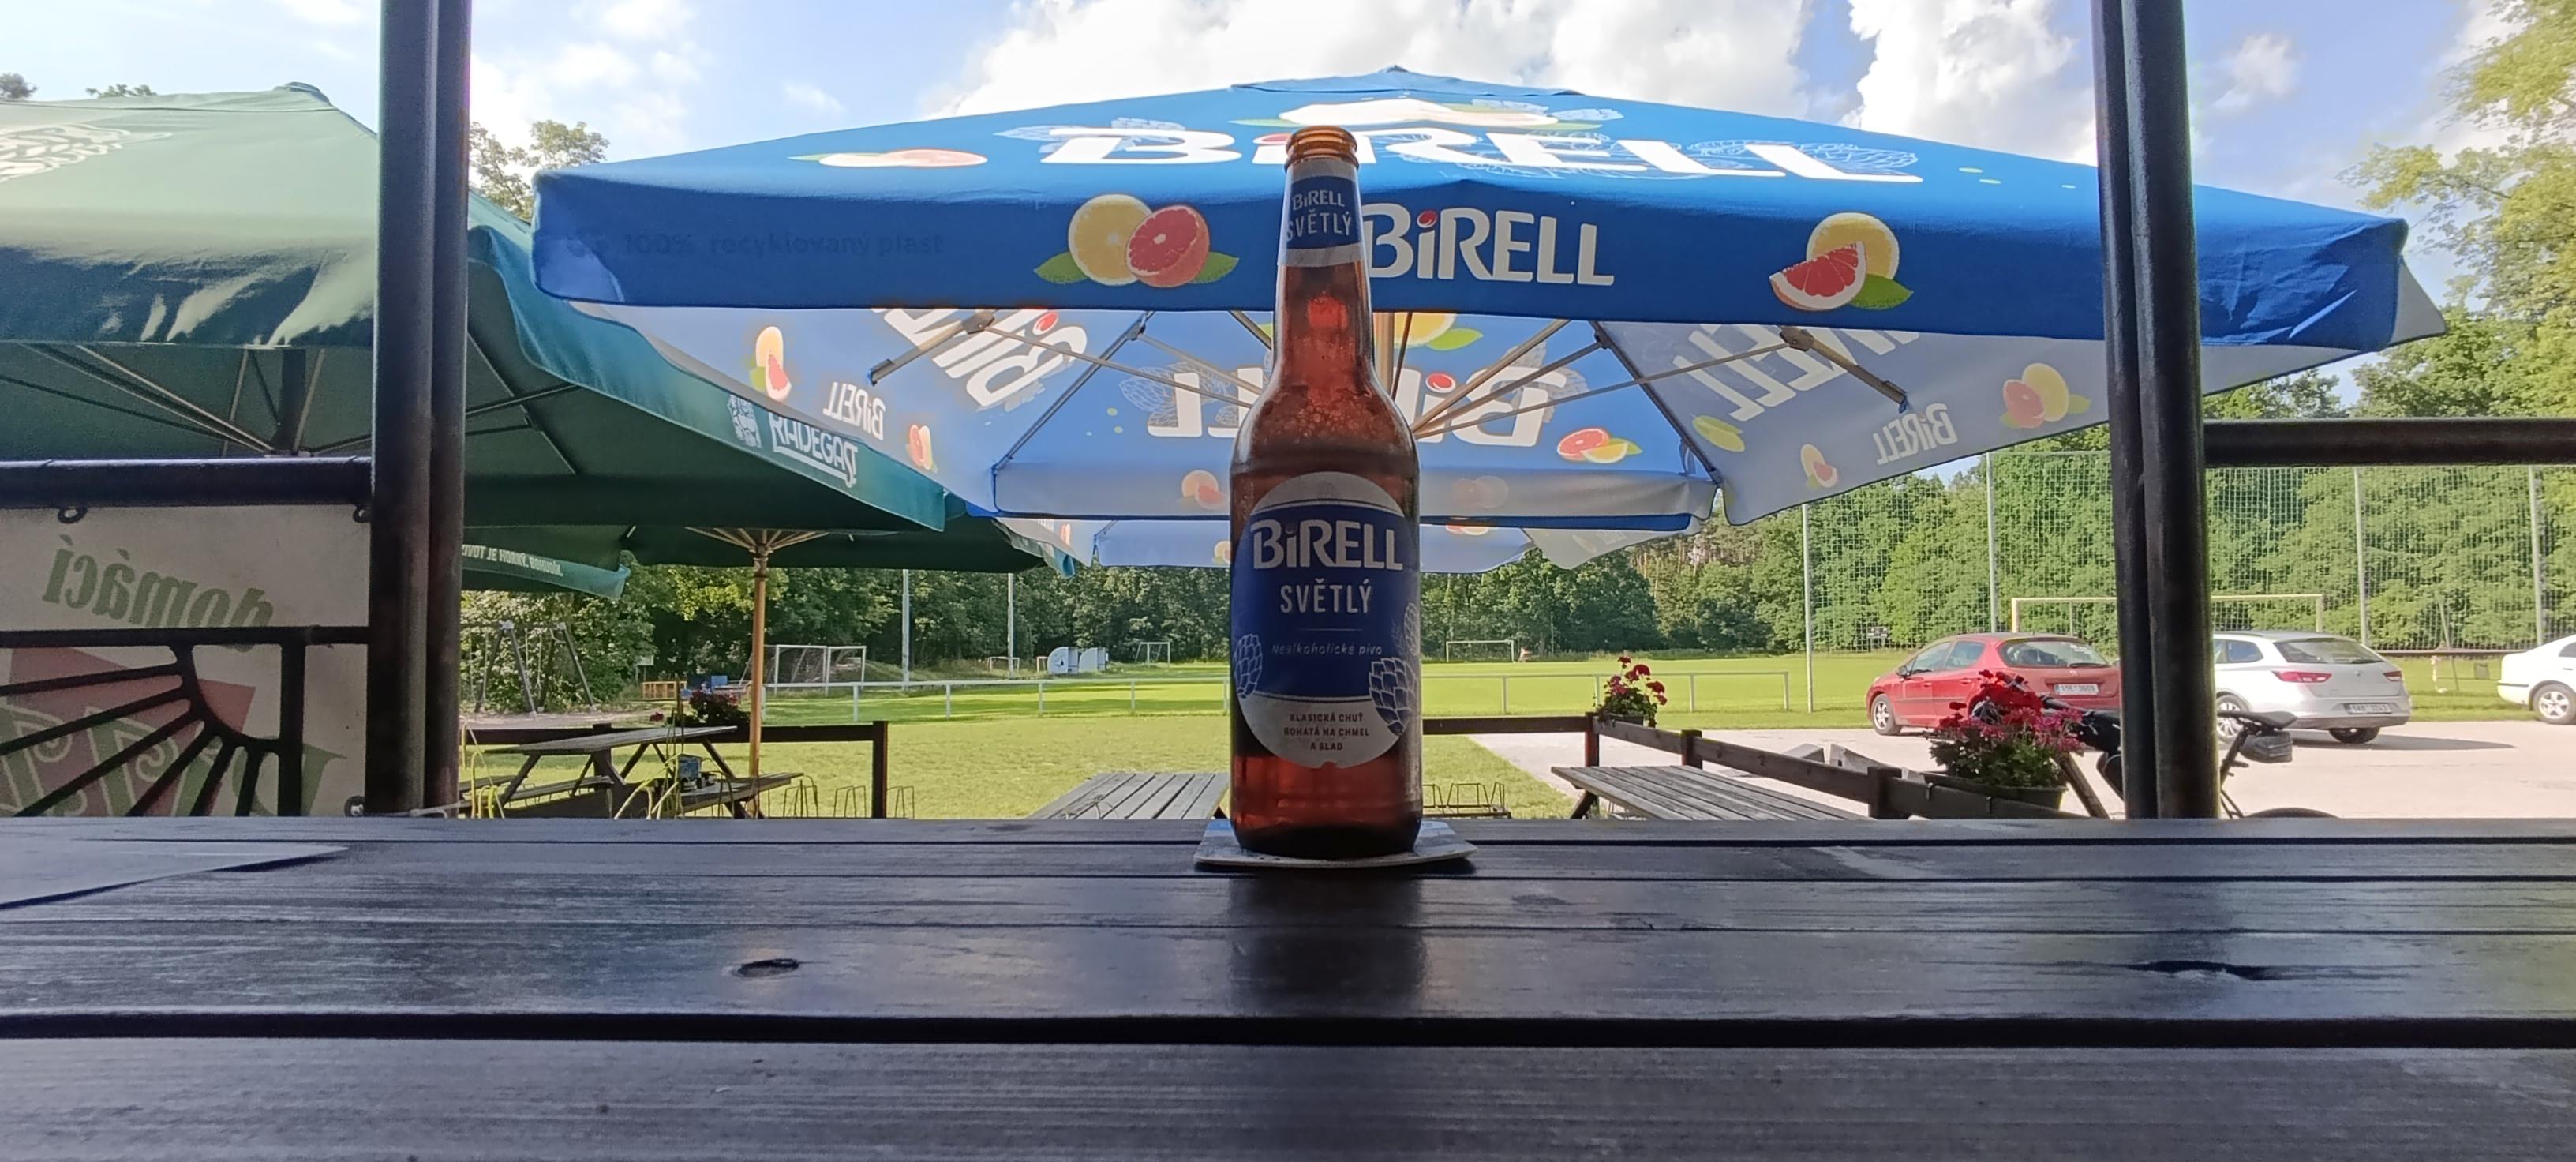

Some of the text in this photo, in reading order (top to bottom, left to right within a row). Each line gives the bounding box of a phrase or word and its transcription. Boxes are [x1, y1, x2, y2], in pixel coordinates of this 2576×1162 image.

[1292, 189, 1345, 211] BiRELL
[1286, 208, 1351, 242] SVĚTLÝ
[623, 234, 694, 254] 100%
[1361, 203, 1615, 286] BiRELL
[487, 546, 497, 562] JE
[1250, 519, 1403, 571] BiRELL
[1280, 577, 1372, 613] SVĚTLÝ
[1271, 642, 1383, 656] Nealkoholické pivo
[1290, 712, 1364, 722] KLASICKÁ CHUŤ
[1283, 725, 1369, 737] BOHATÁ NA CHMEL
[1310, 742, 1343, 751] A SLAD
